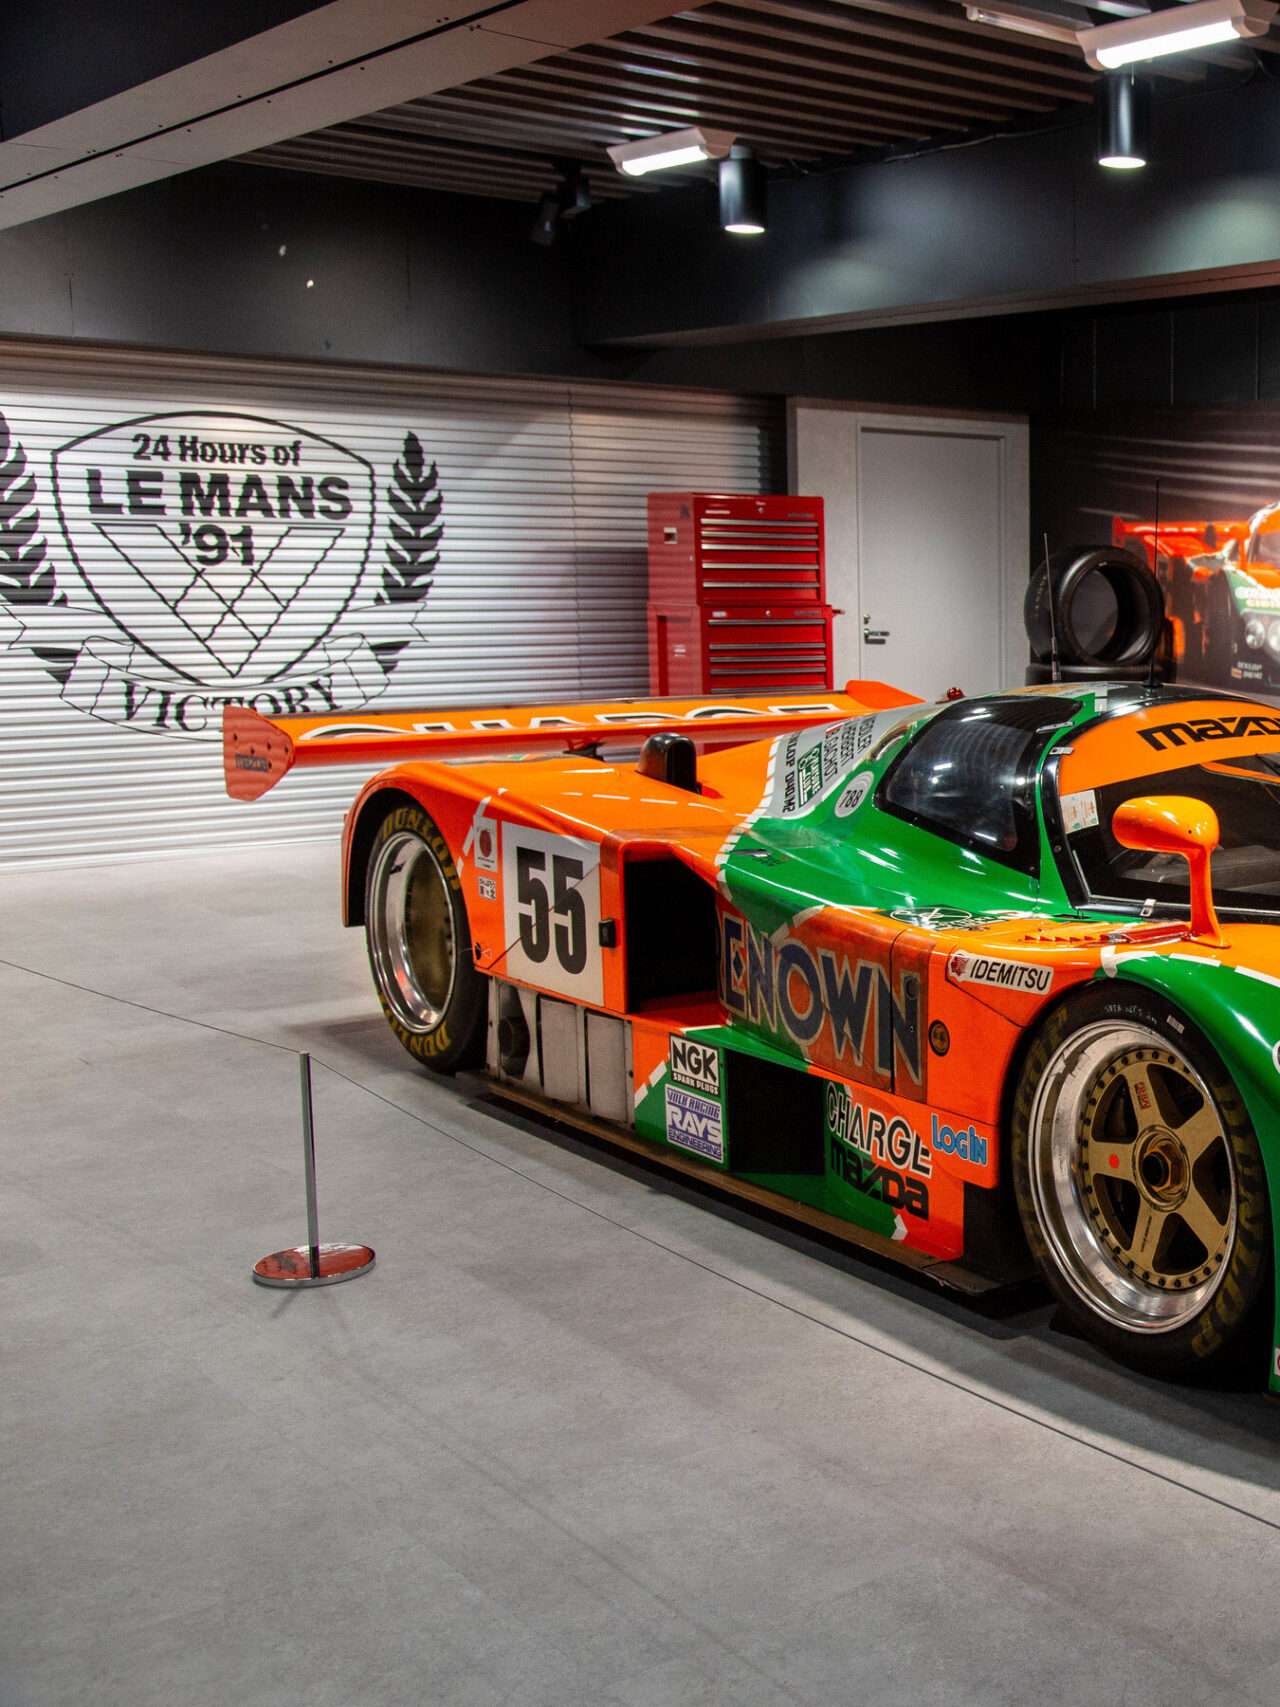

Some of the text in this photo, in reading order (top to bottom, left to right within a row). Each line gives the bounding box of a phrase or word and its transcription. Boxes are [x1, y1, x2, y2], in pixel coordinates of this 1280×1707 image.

[132, 432, 302, 466] 24 Hours of
[86, 468, 353, 521] LE MANS
[178, 522, 255, 566] '91
[516, 846, 588, 975] 55
[970, 960, 1050, 991] IDEMITSU
[721, 911, 924, 1085] ENOWN
[672, 1040, 718, 1083] NGK
[688, 1098, 720, 1119] RACING
[696, 1080, 719, 1095] PLUGS
[668, 1105, 721, 1144] RAYS
[826, 1081, 933, 1178] CHARGE
[831, 1138, 929, 1220] mazda
